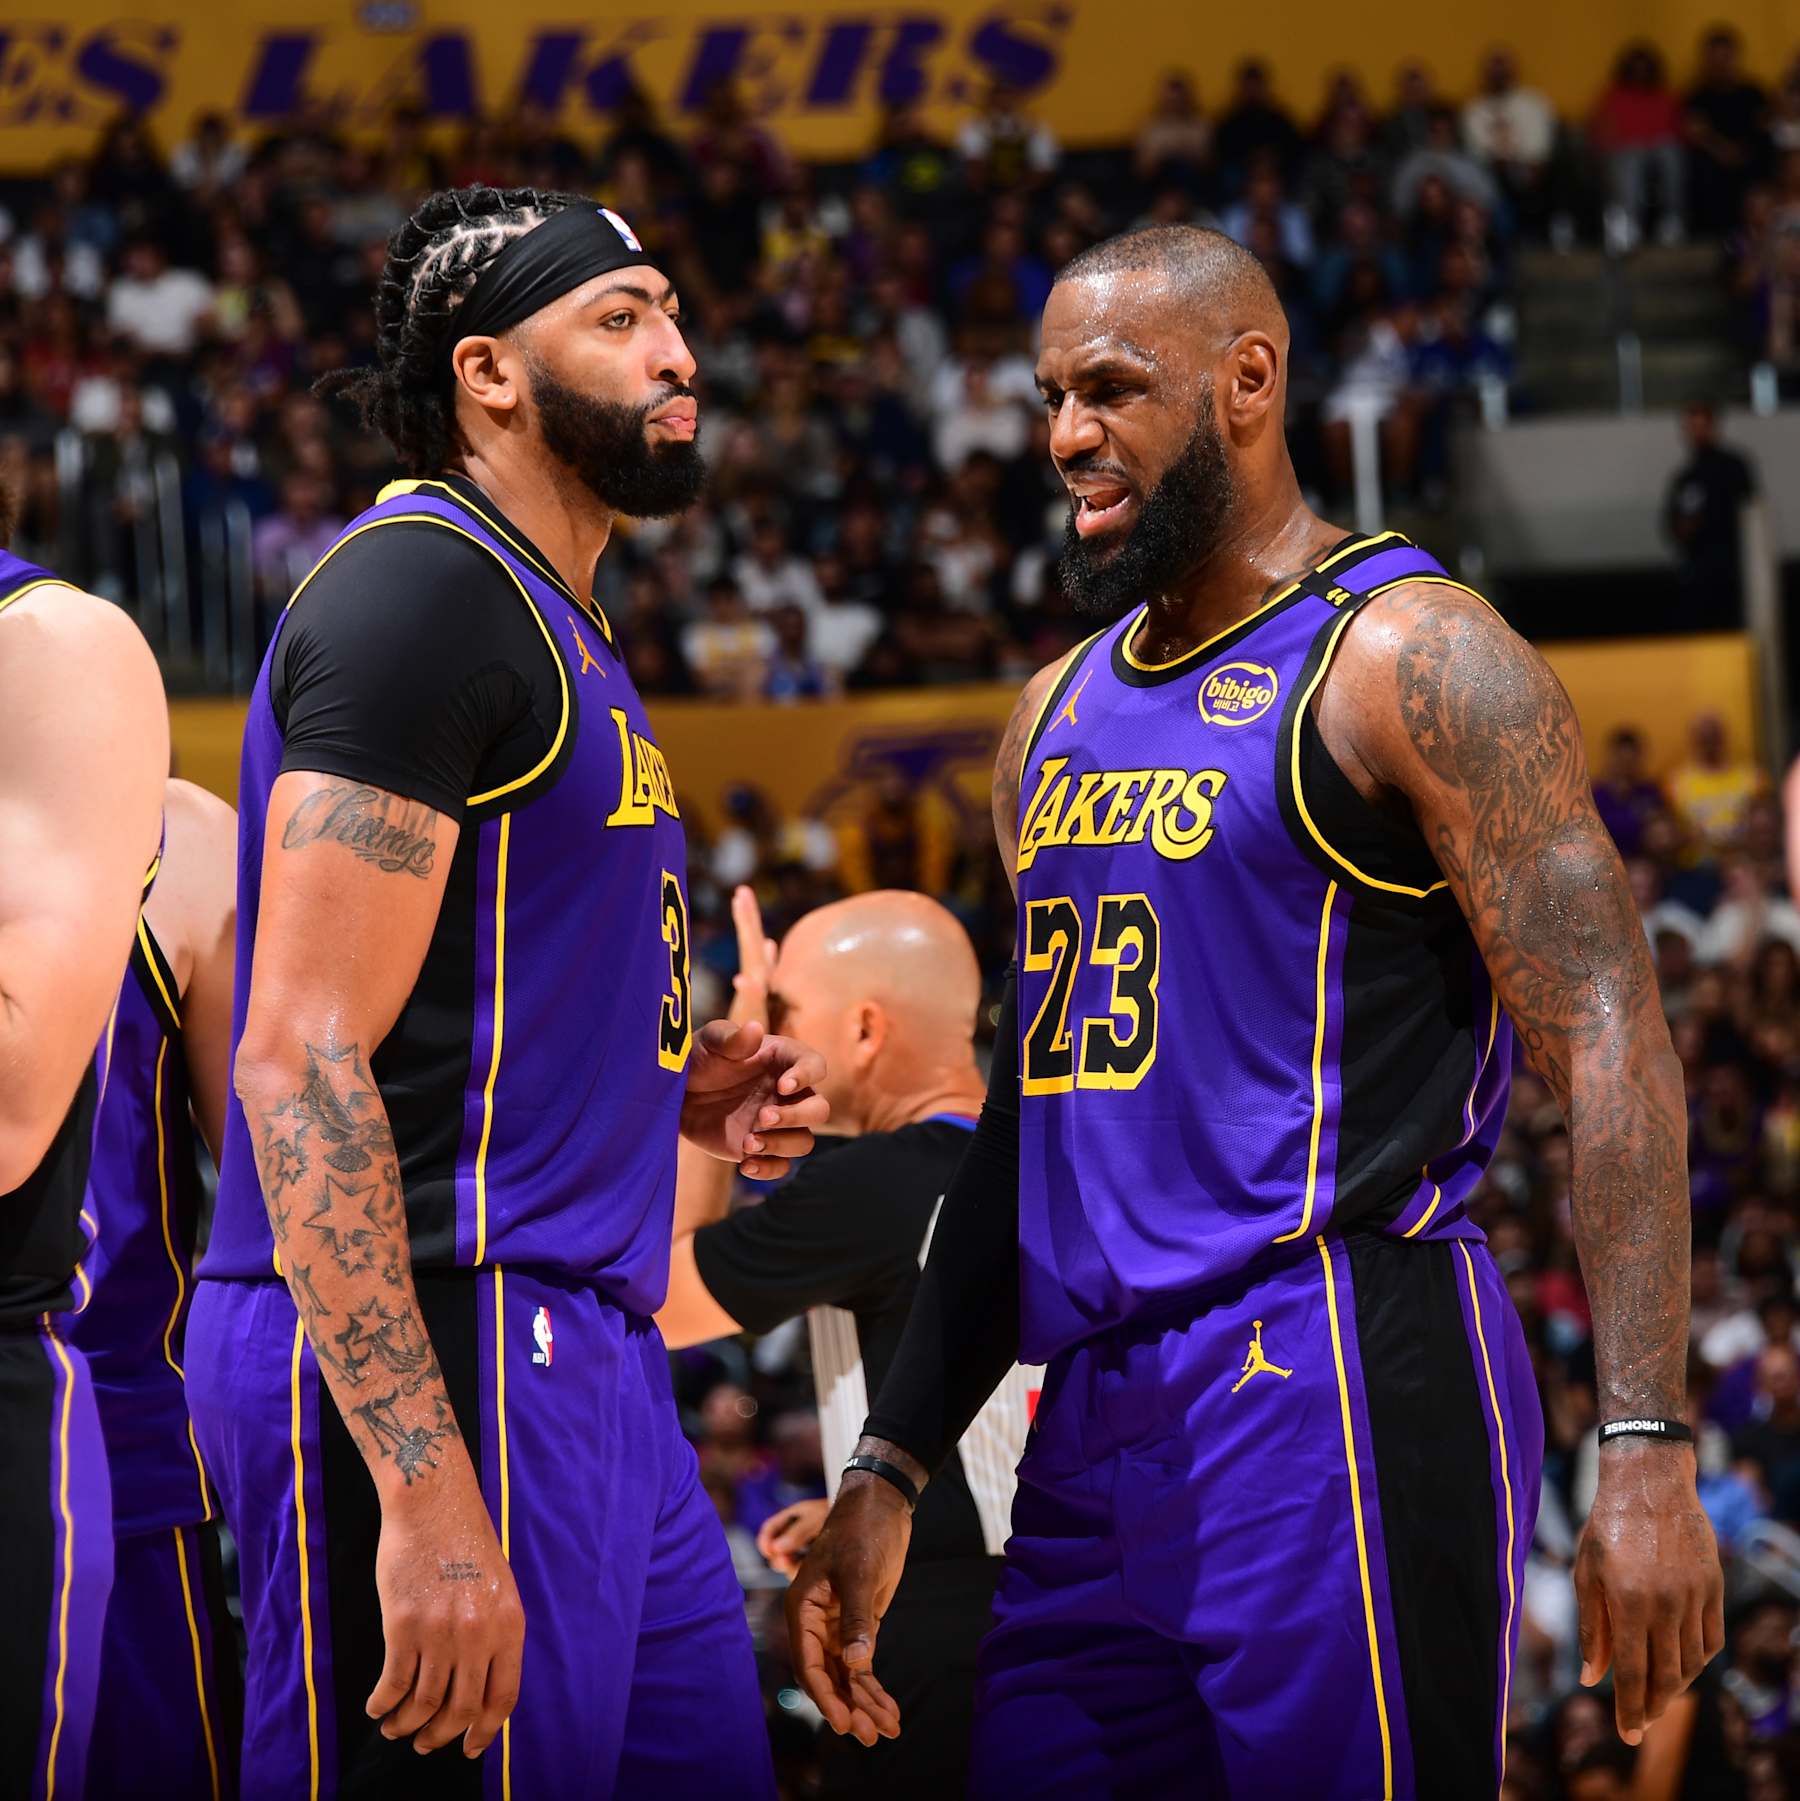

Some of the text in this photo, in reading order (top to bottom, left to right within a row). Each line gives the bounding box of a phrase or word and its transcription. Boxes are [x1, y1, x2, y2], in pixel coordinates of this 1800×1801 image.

[238, 6, 1074, 122] LAKERS
[1206, 676, 1272, 709] bibigo
[1212, 698, 1240, 712] 비비고
[1016, 754, 1229, 874] LAKERS
[658, 867, 693, 1073] 3
[1022, 893, 1160, 1096] 23
[1605, 1420, 1660, 1435] PROMISE
